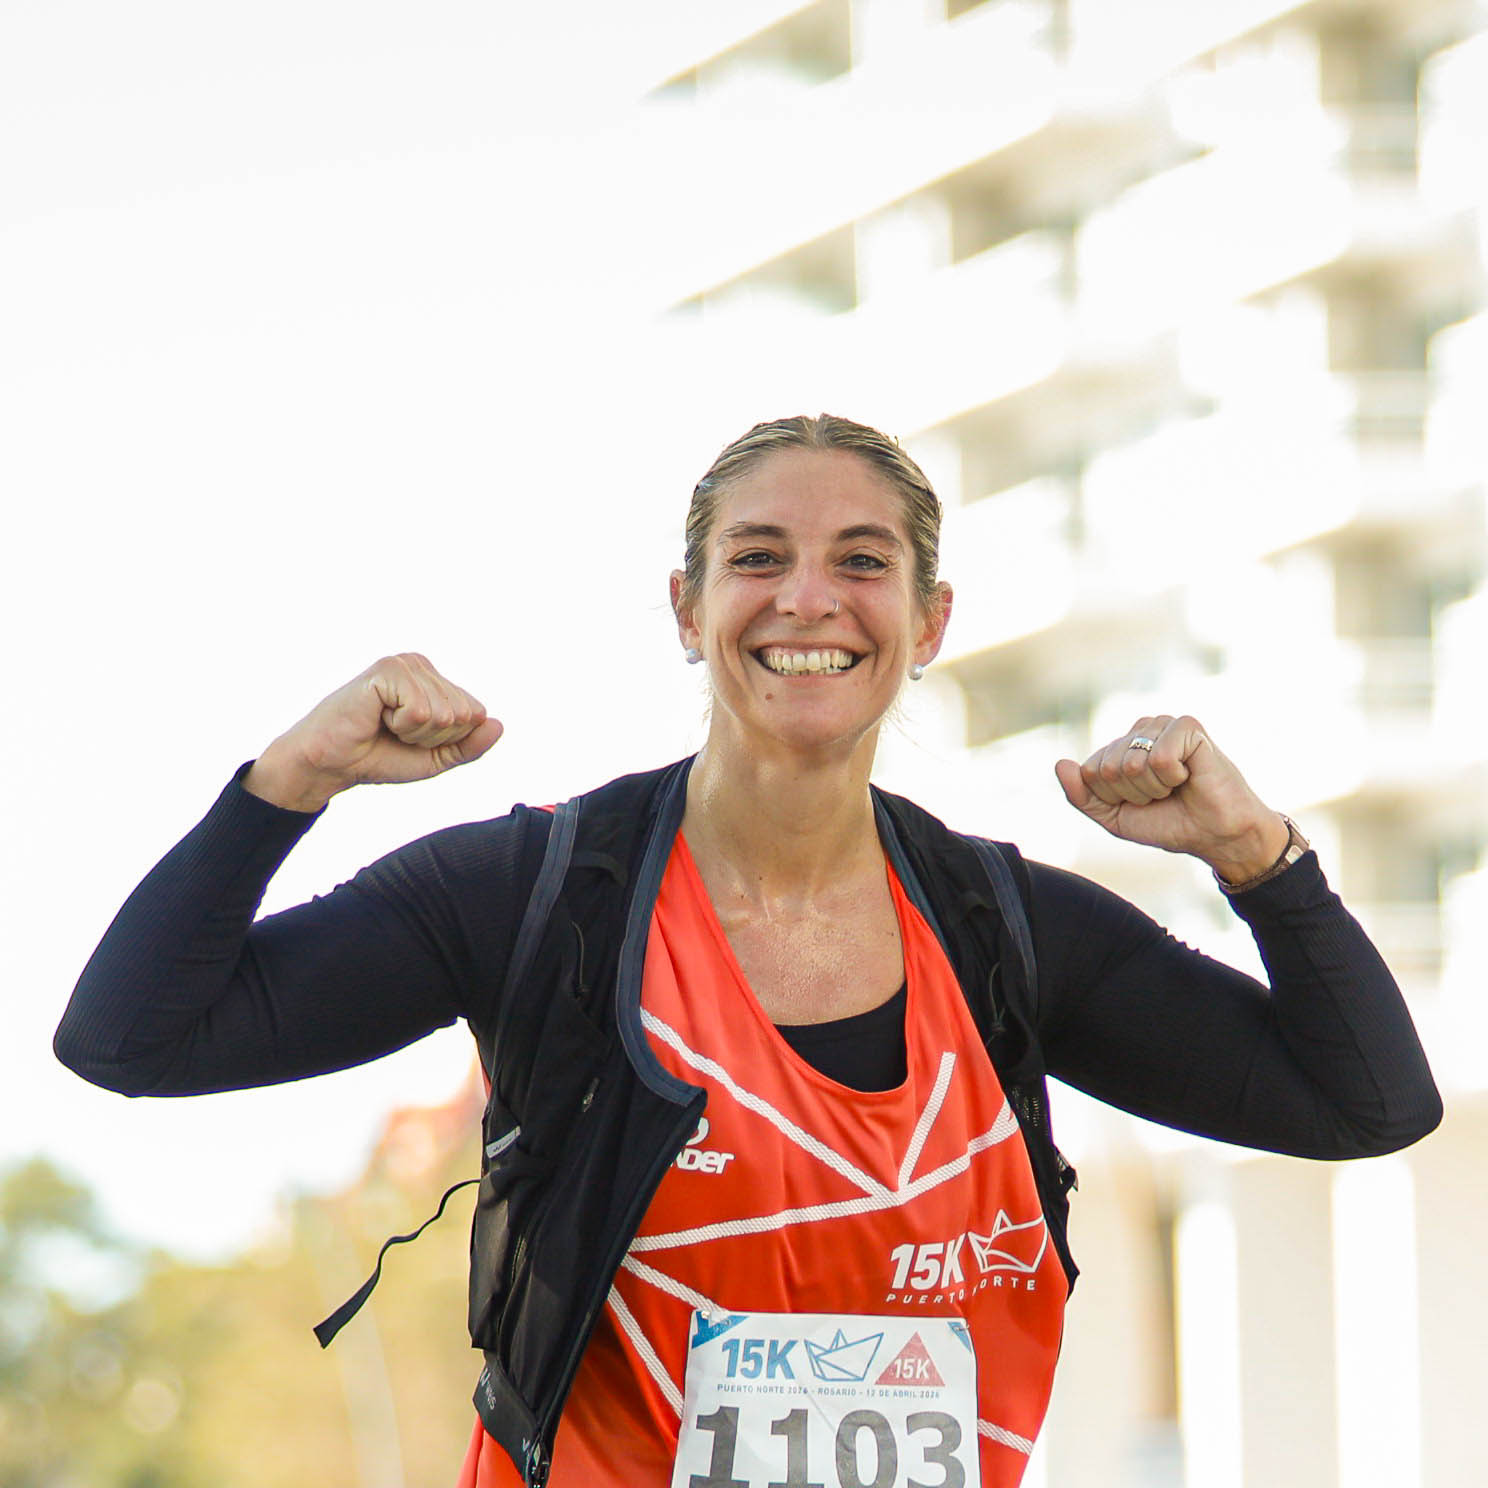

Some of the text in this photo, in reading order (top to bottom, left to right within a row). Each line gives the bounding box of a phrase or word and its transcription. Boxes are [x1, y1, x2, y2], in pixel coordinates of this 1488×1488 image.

[890, 1233, 966, 1291] 15K
[886, 1289, 966, 1304] PUERTO
[721, 1338, 930, 1380] 15K 15K
[716, 1383, 754, 1394] PUERTO
[756, 1385, 785, 1395] NORTE
[817, 1387, 857, 1397] ROSARIO
[879, 1389, 890, 1398] DE
[893, 1389, 917, 1399] ABRIL
